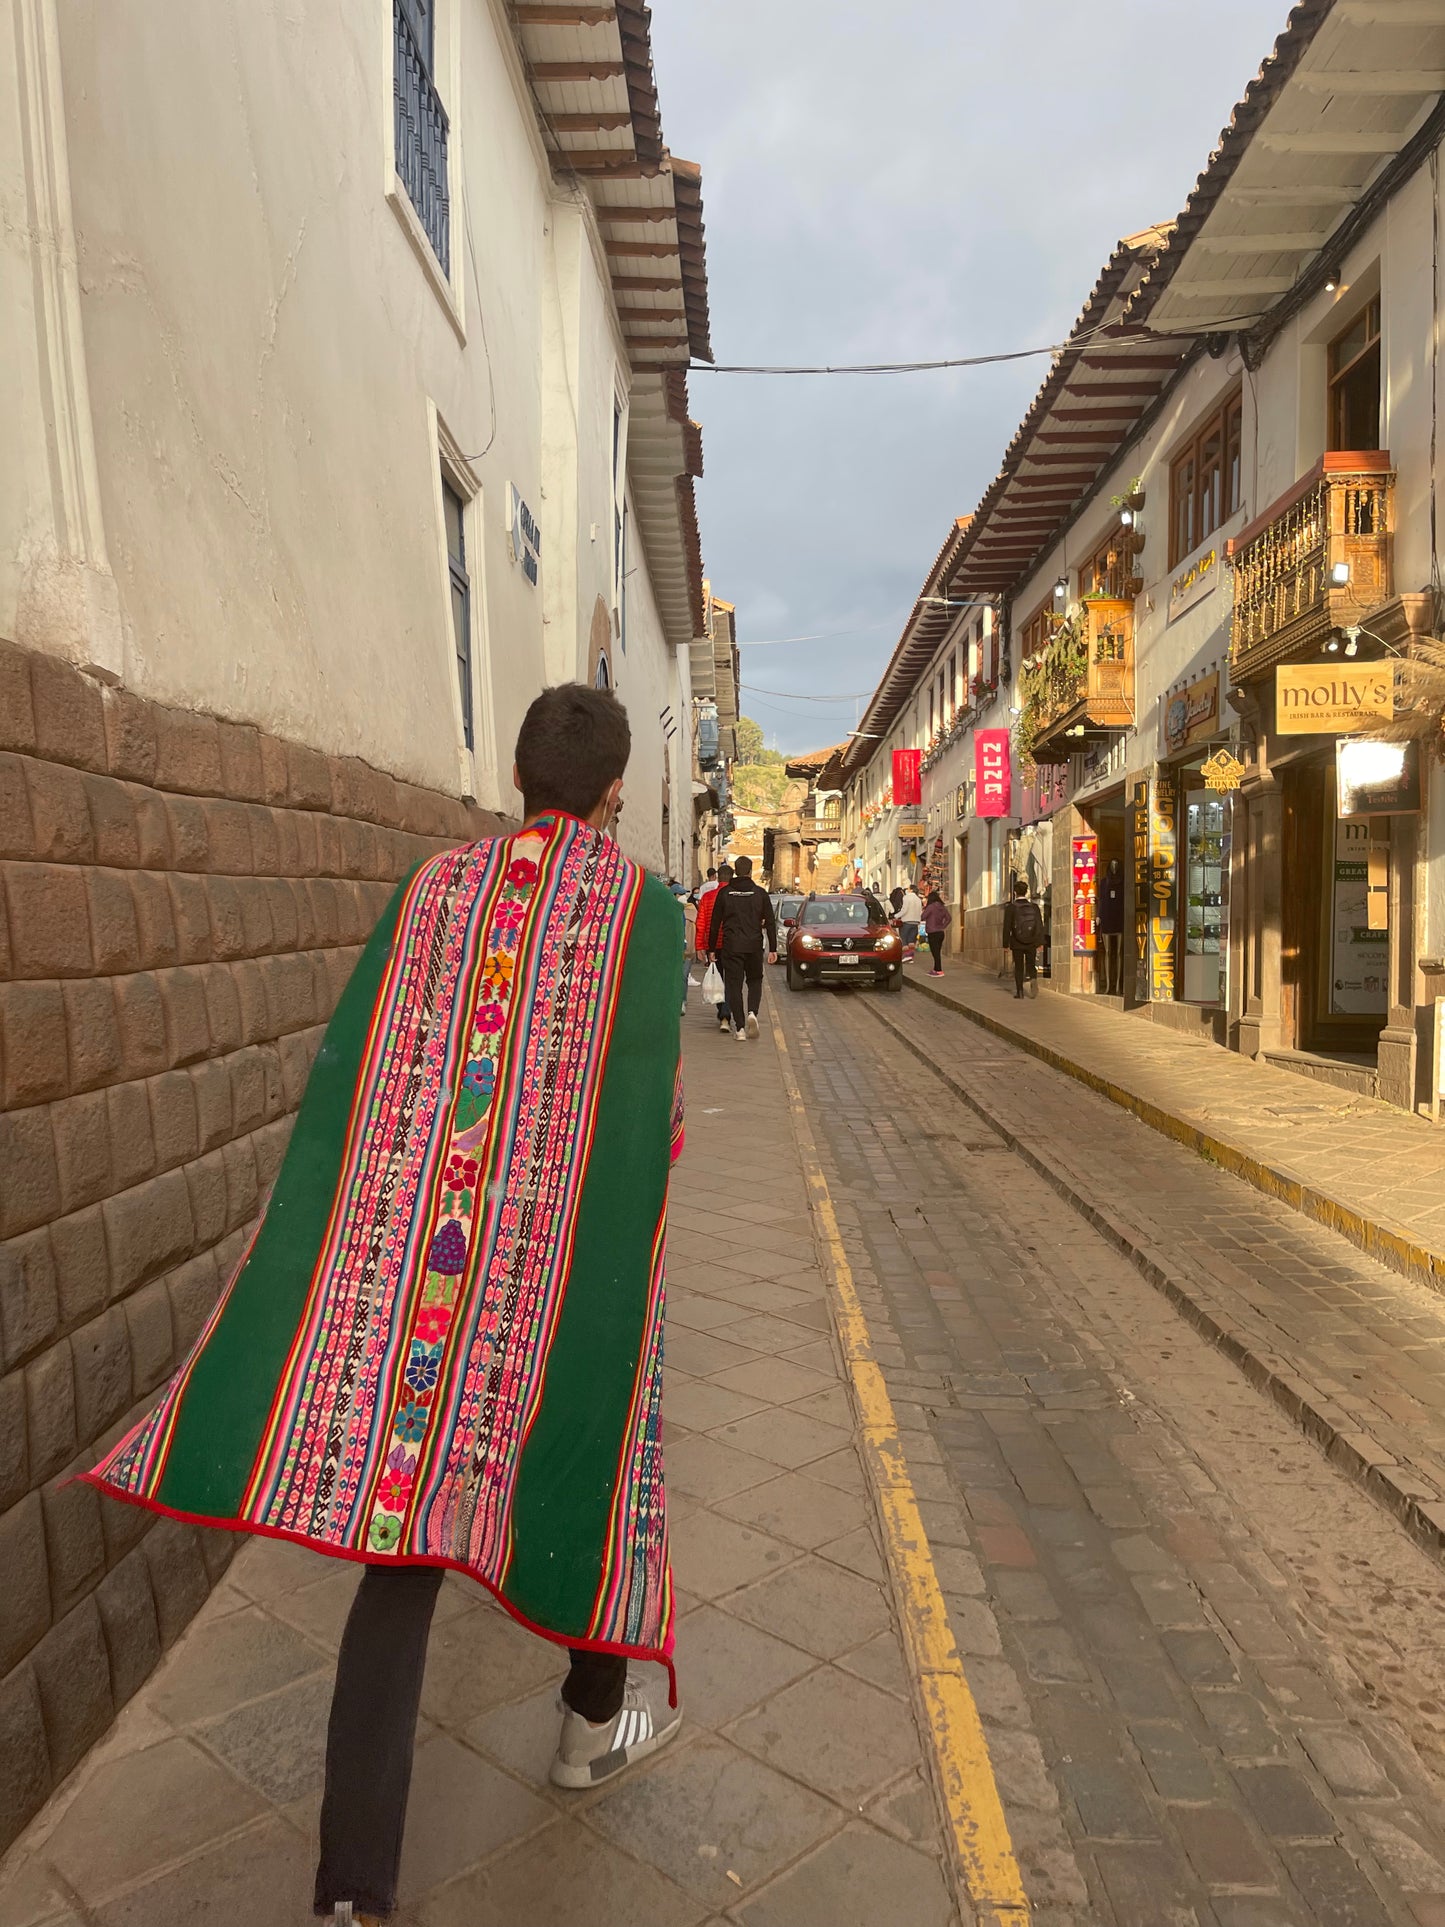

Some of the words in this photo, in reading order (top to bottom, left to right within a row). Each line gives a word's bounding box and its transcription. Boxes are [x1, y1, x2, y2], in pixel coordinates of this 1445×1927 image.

[1283, 678, 1388, 710] molly's
[1206, 780, 1239, 788] MUNAY
[1153, 797, 1175, 869] GOLD
[1134, 783, 1147, 959] JEWELRY
[1153, 881, 1174, 988] SILVER
